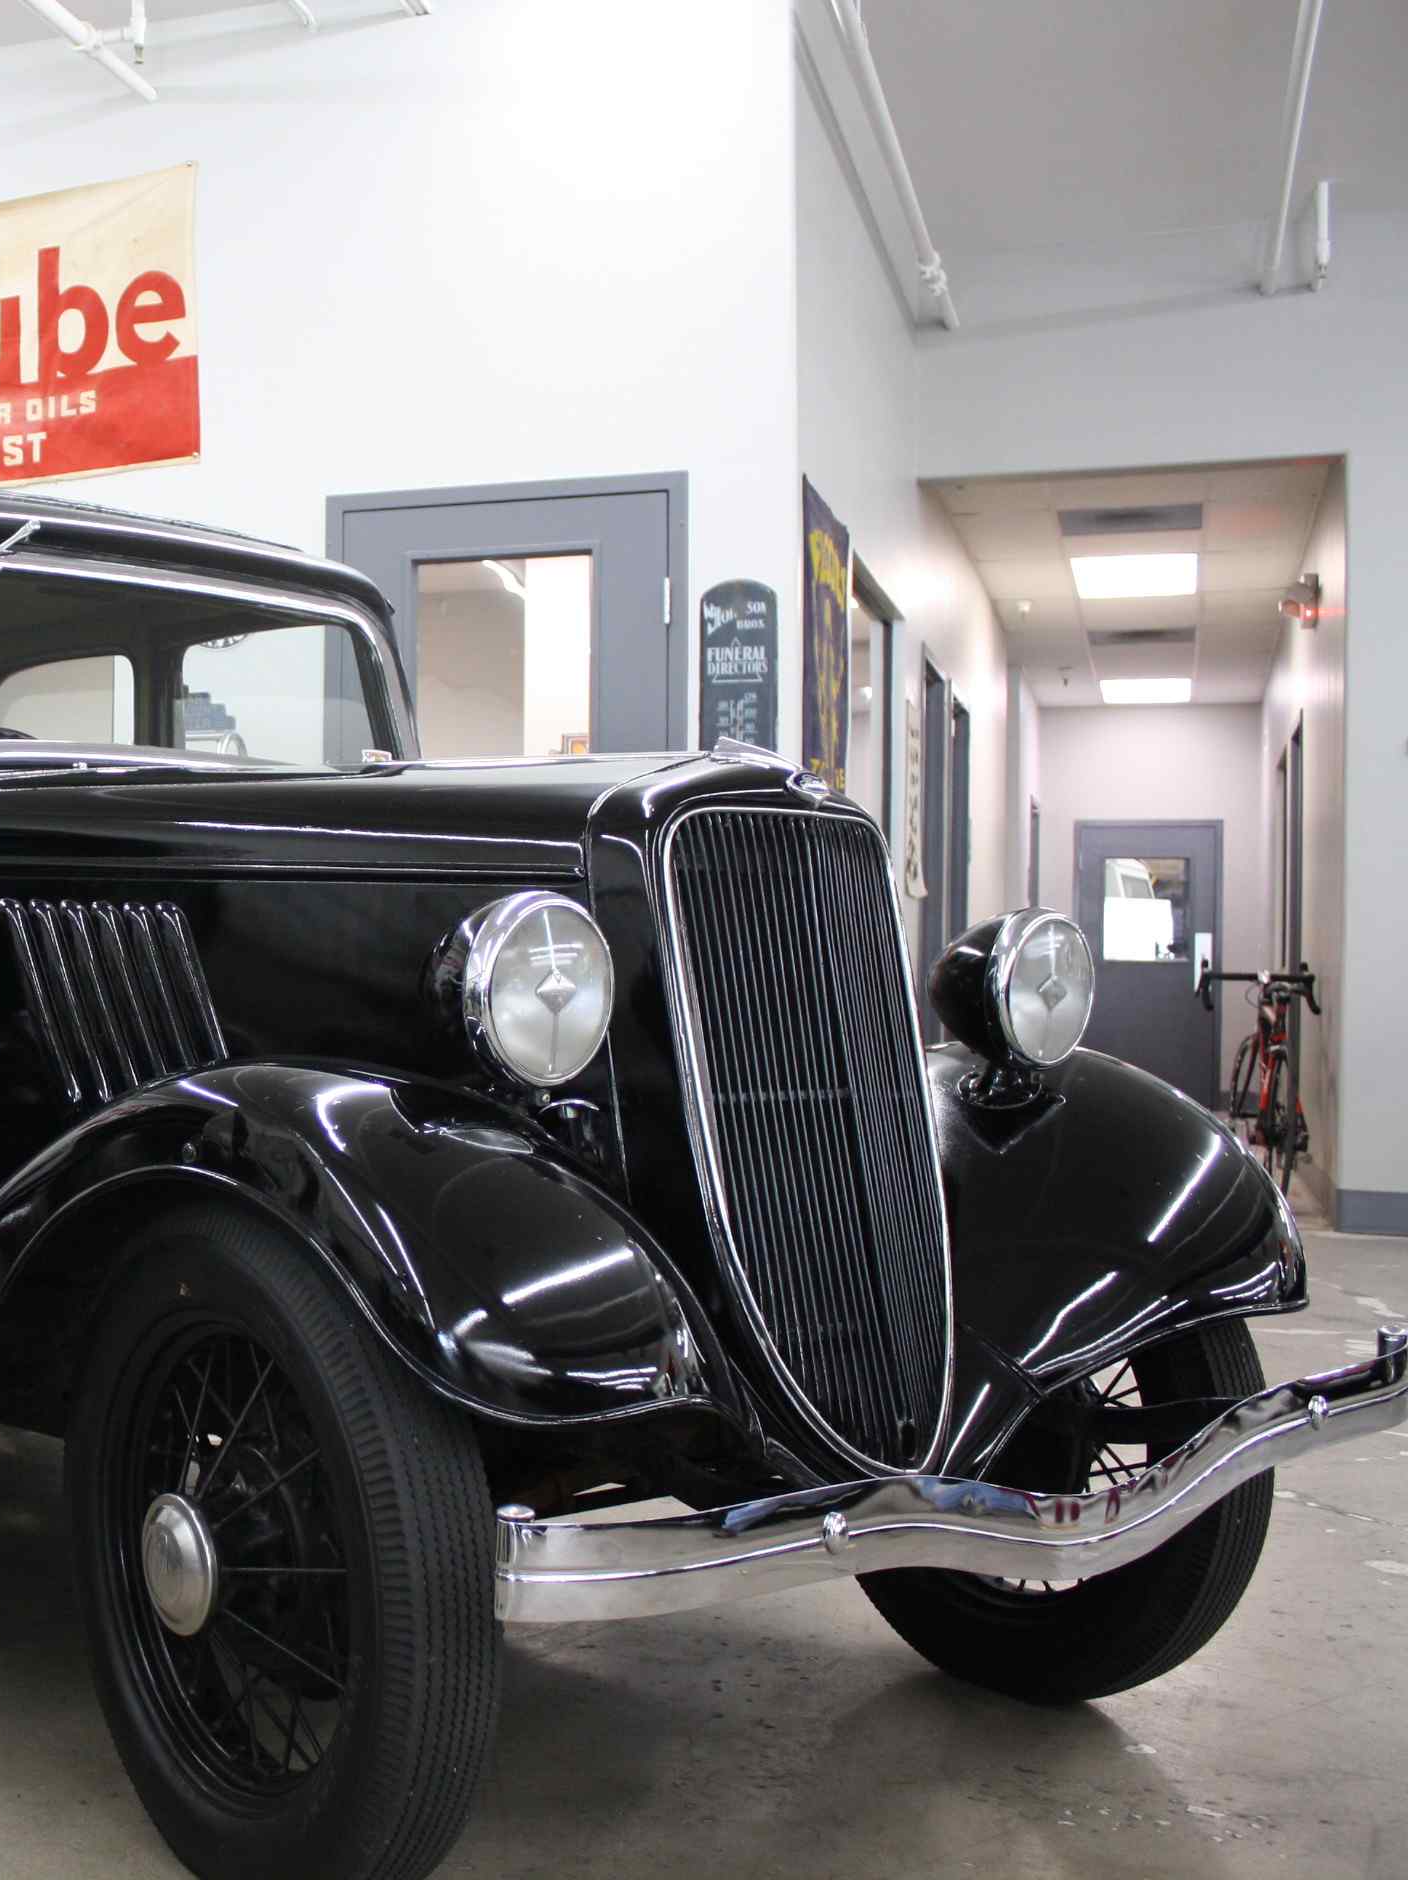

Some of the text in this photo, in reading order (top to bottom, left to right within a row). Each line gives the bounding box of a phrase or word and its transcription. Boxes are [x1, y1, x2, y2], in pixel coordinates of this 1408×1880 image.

[25, 389, 97, 422] OILS
[707, 645, 766, 662] FUNERAL
[707, 659, 769, 675] DIRECTORS
